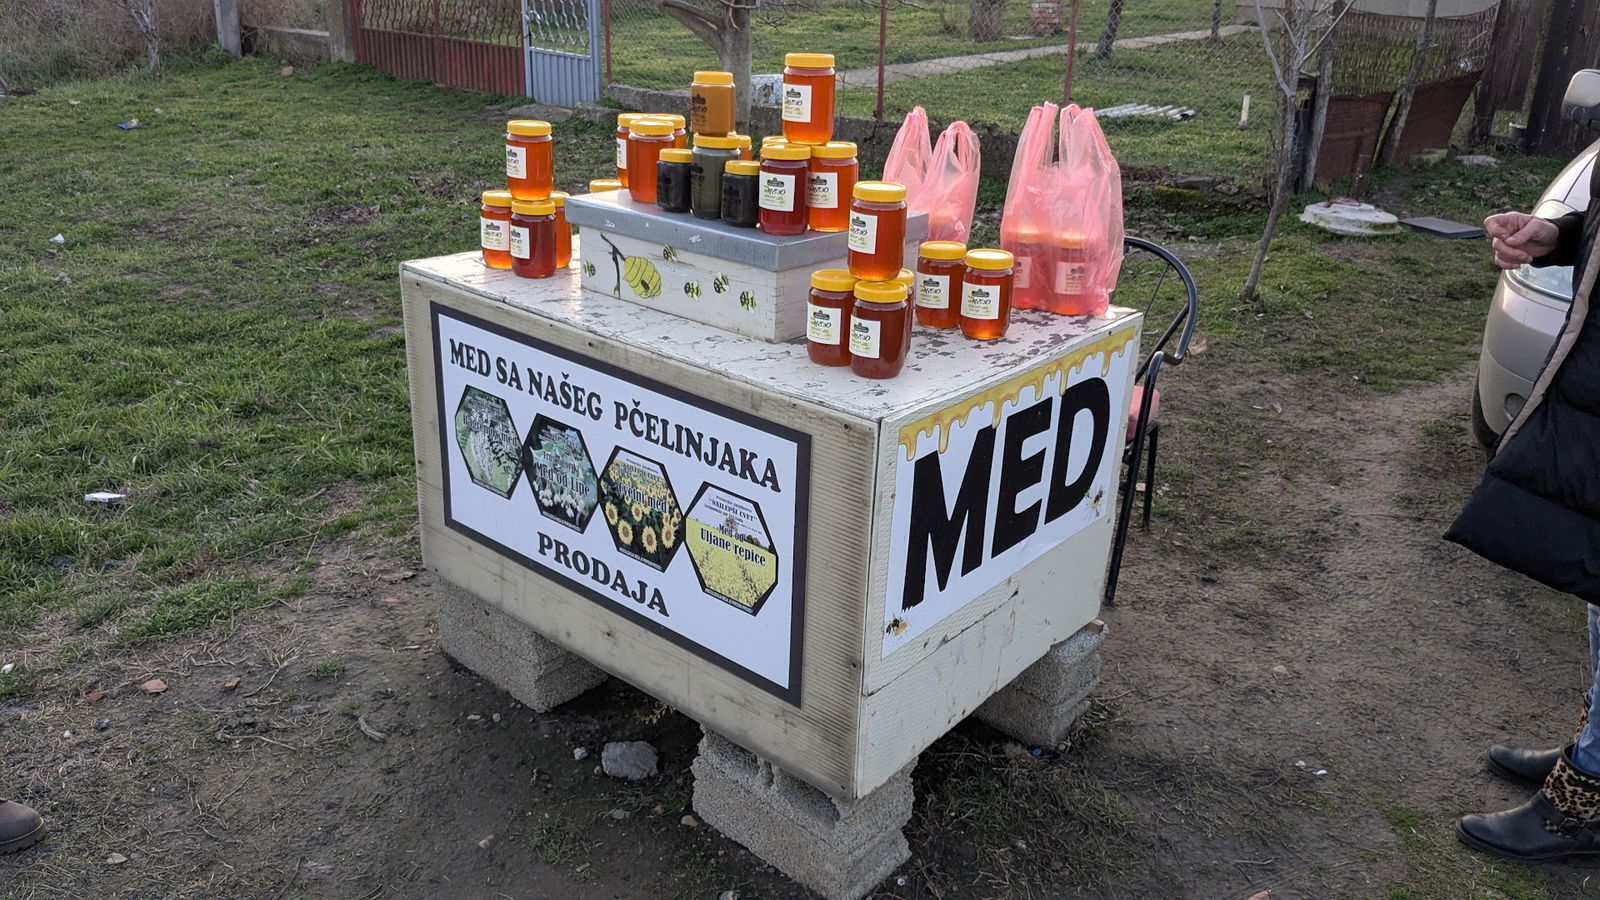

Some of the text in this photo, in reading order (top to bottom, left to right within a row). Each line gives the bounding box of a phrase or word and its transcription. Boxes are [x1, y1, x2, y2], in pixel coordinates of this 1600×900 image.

[449, 338, 491, 378] MED
[496, 357, 523, 392] SA
[528, 368, 603, 421] NAŠEG
[614, 398, 782, 493] PČELINJAKA
[536, 461, 589, 499] Med od Lipe
[618, 479, 666, 514] Cvetni med
[902, 376, 1110, 611] MED
[700, 527, 730, 553] Uljane
[734, 541, 765, 568] repice
[718, 523, 732, 538] Med
[734, 530, 744, 543] od
[537, 532, 669, 617] PRODAJA
